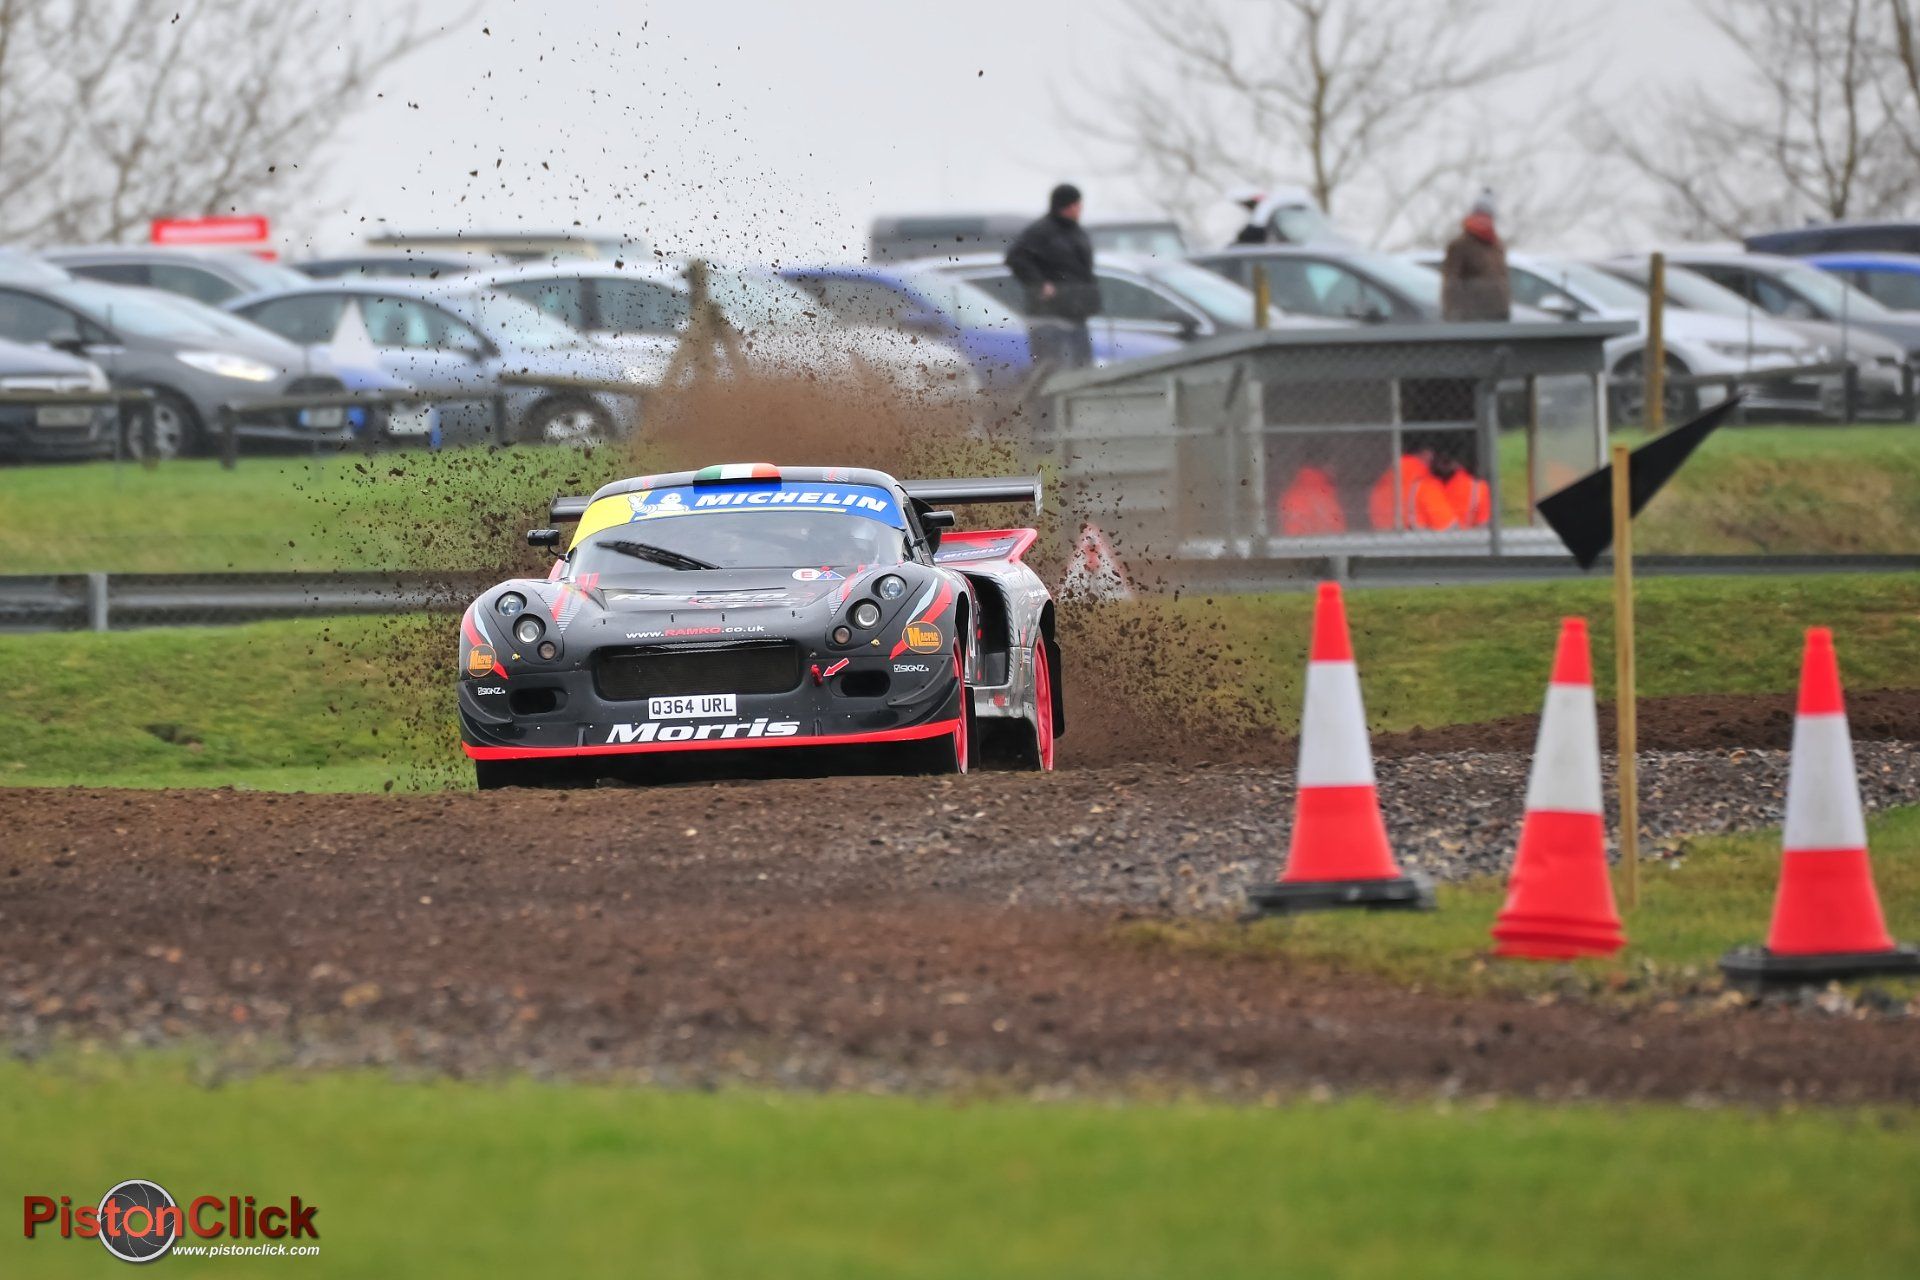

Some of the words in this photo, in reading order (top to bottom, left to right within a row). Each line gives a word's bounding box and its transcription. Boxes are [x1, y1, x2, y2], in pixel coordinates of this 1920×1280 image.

[695, 491, 888, 513] MICHELIN
[801, 571, 814, 579] E
[626, 625, 765, 639] www.RAMKO.co.uk
[651, 699, 694, 715] Q364
[701, 697, 733, 713] URL
[606, 717, 800, 744] Morris
